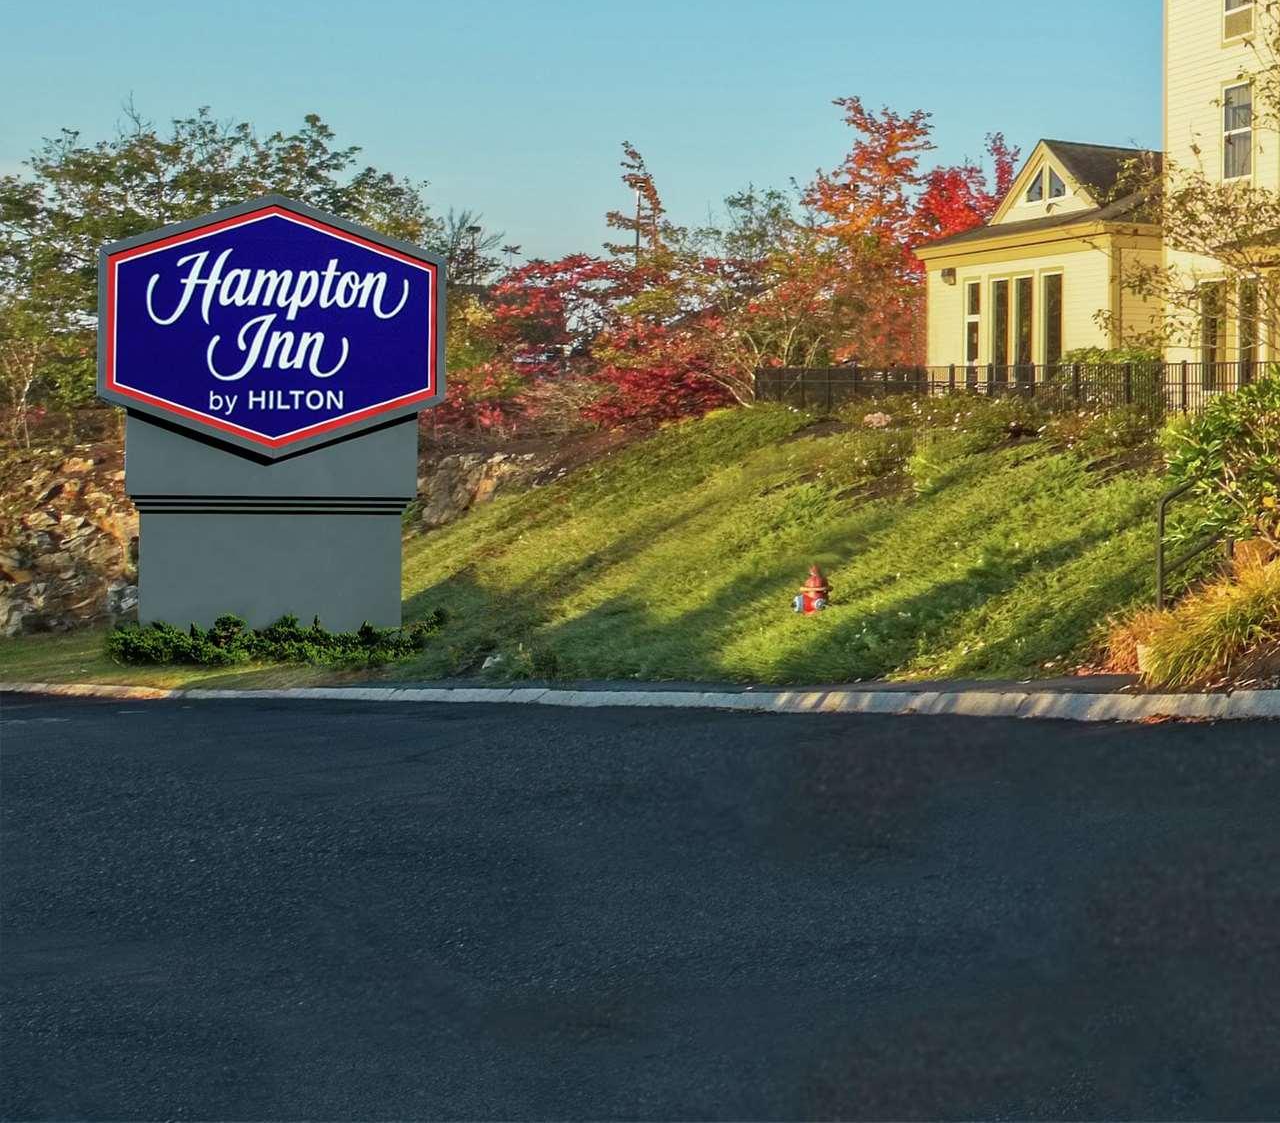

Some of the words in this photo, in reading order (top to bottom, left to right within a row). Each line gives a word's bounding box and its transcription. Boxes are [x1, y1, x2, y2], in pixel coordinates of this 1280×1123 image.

[146, 248, 409, 325] Hampton
[207, 313, 349, 381] Inn
[208, 390, 238, 415] by
[248, 390, 344, 410] HILTON
